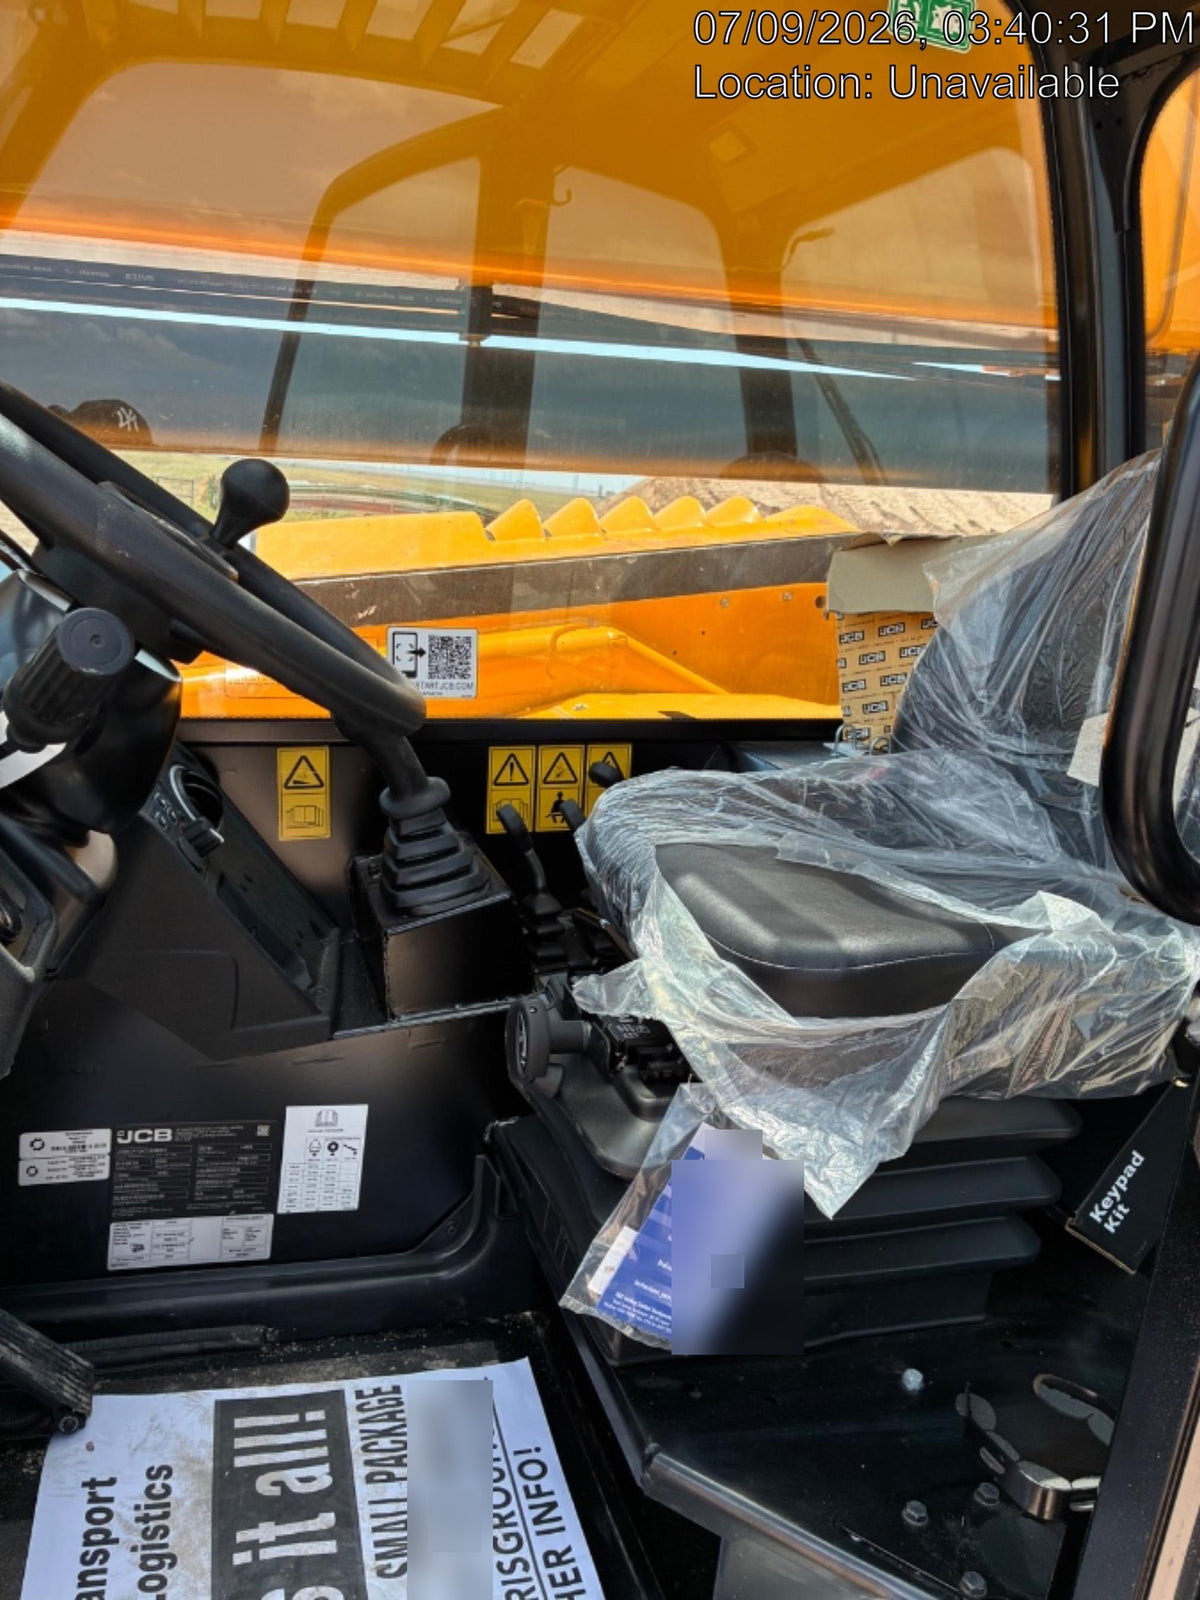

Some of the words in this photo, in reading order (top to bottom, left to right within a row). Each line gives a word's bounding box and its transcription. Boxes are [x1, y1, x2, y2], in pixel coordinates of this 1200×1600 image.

[840, 631, 864, 643] JCB
[879, 622, 904, 636] JCB
[860, 651, 884, 664] JCB
[116, 1128, 173, 1144] JCB
[1089, 1150, 1145, 1223] Keypad
[1103, 1202, 1131, 1234] Kit
[234, 1410, 333, 1495] all!
[355, 1385, 407, 1485] PACKAGE
[513, 1446, 566, 1536] INFO!
[130, 1465, 178, 1600] ogistics
[233, 1512, 338, 1566] it
